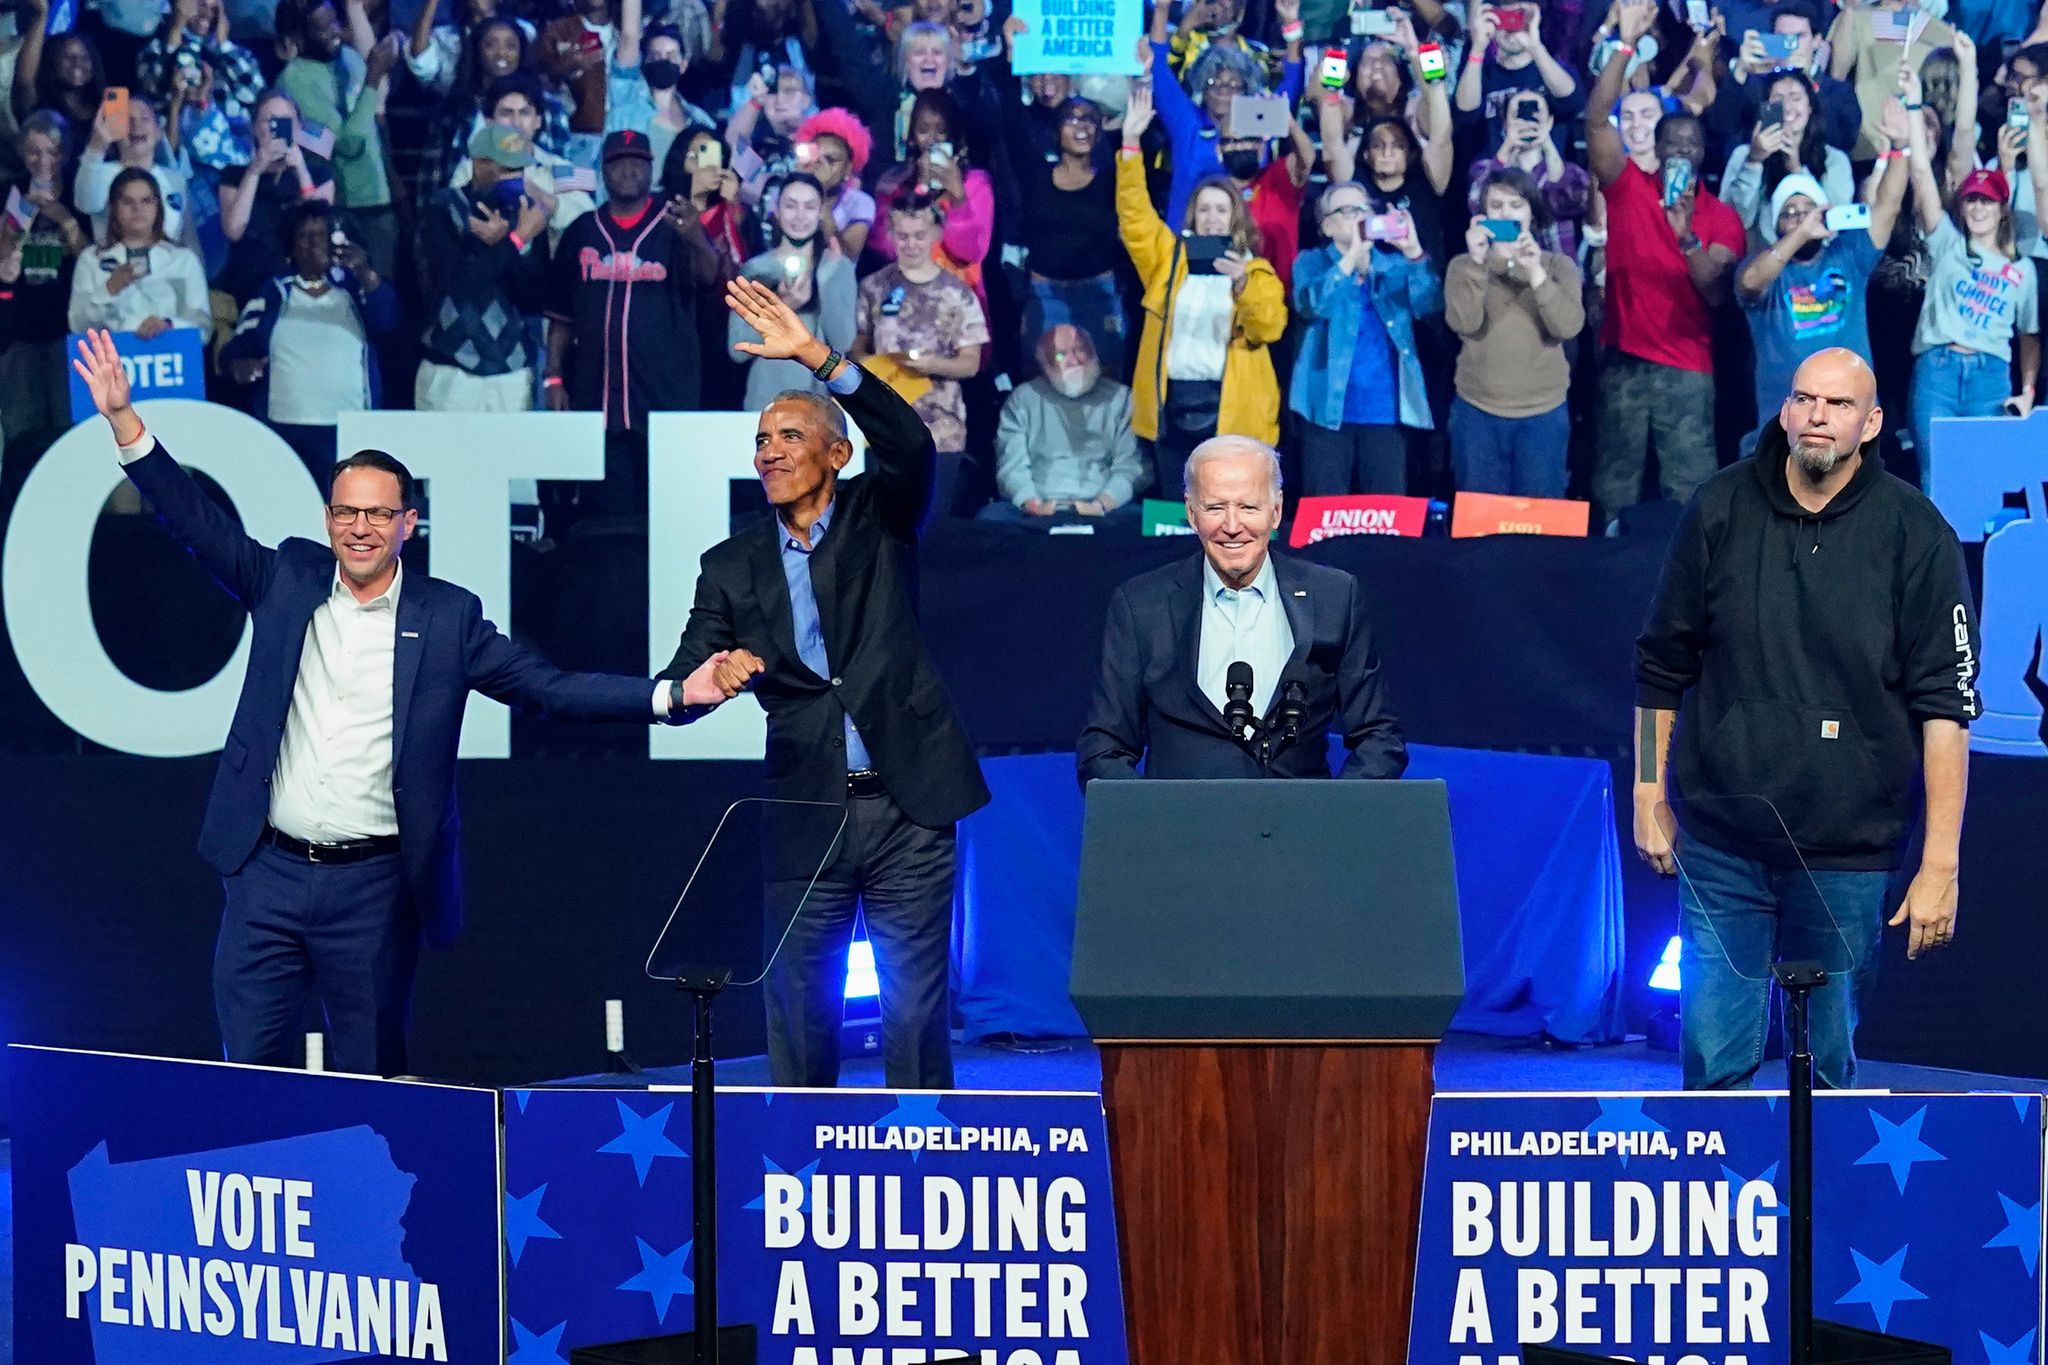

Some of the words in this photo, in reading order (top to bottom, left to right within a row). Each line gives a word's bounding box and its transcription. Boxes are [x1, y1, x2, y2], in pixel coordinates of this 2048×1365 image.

[1041, 0, 1115, 16] BUILDING
[1042, 19, 1052, 36] A
[1056, 19, 1114, 36] BETTER
[1042, 39, 1113, 57] AMERICA
[1321, 508, 1396, 529] UNION
[816, 1126, 1041, 1157] PHILADELPHIA,
[1050, 1128, 1089, 1152] PA
[1450, 1131, 1678, 1160] PHILADELPHIA,
[1686, 1131, 1726, 1155] PA
[186, 1169, 316, 1259] VOTE
[764, 1174, 1087, 1252] BUILDING
[1452, 1180, 1778, 1257] BUILDING
[65, 1243, 449, 1363] PENNSYLVANIA
[772, 1261, 816, 1335] A
[839, 1261, 1090, 1338] BETTER
[1449, 1268, 1494, 1344] A
[1517, 1268, 1771, 1344] BETTER
